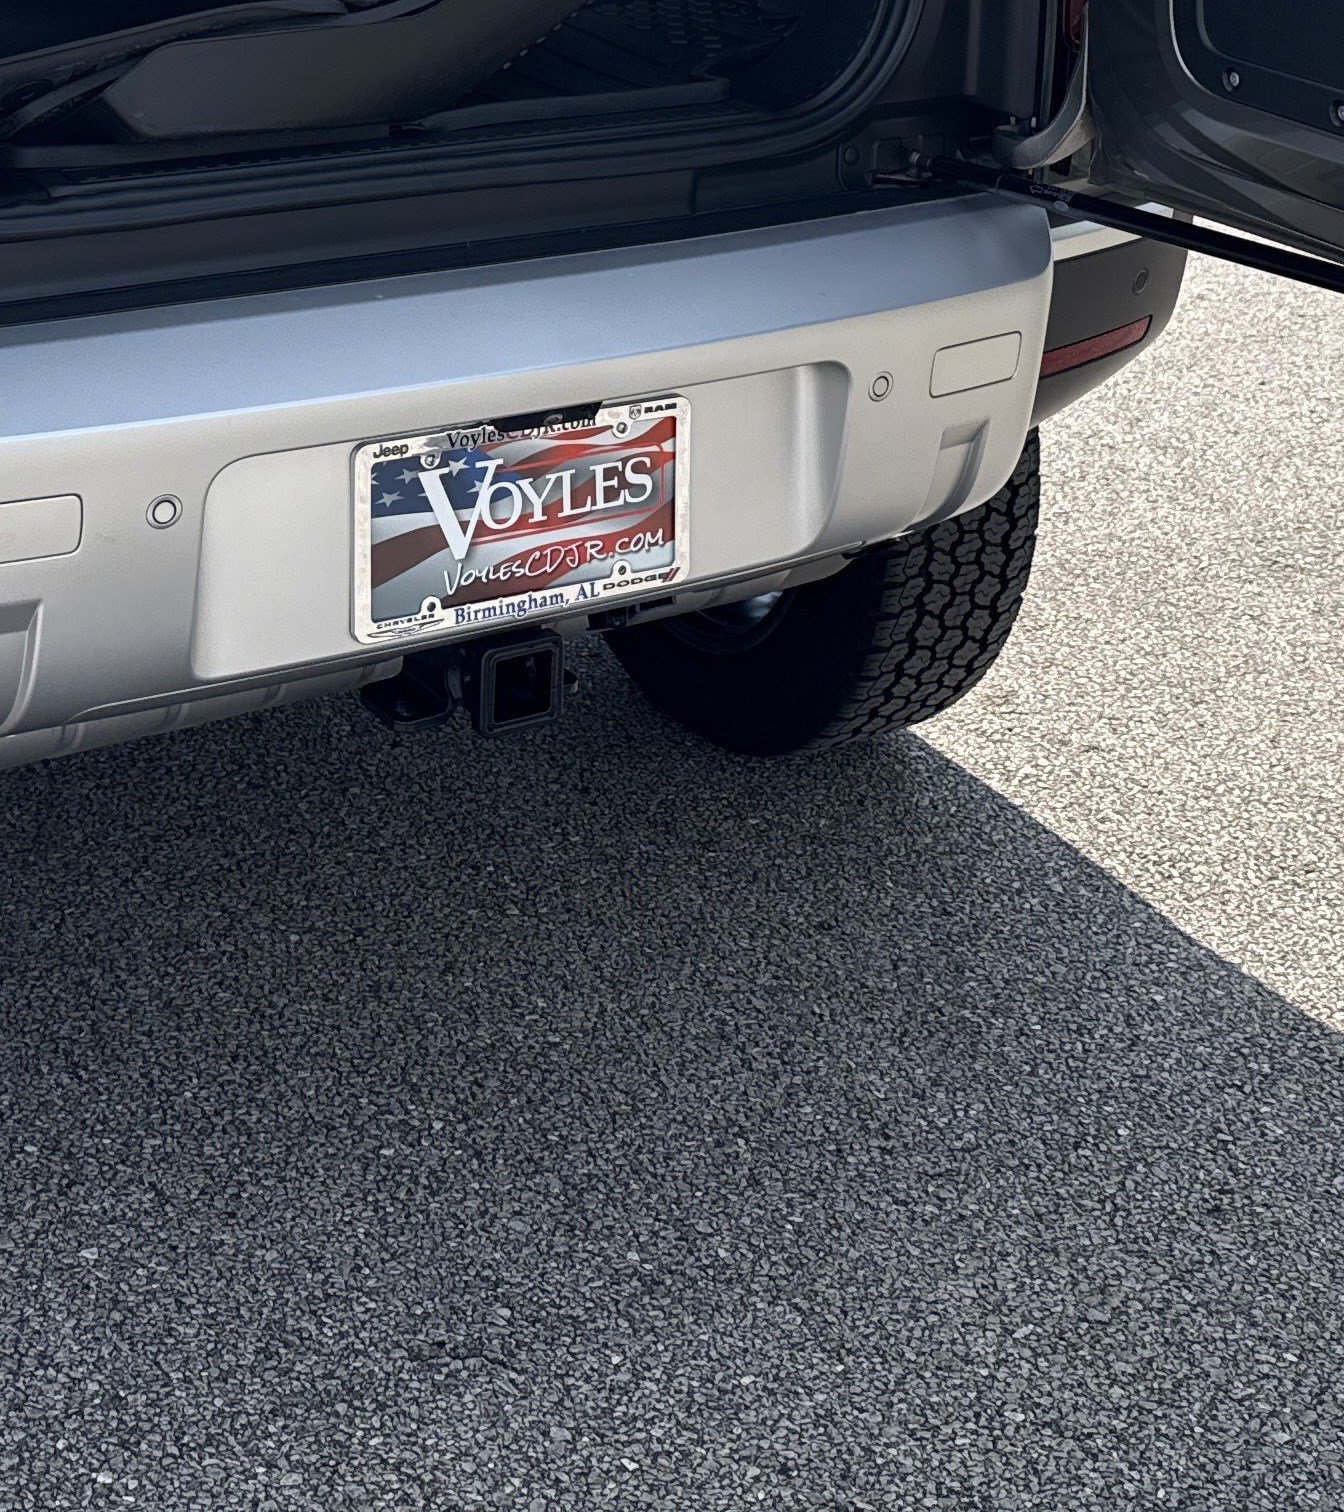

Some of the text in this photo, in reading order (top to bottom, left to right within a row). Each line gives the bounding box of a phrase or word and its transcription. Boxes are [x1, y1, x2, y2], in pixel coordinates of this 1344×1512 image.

[643, 402, 677, 414] RAM
[372, 443, 409, 459] Jeep
[418, 456, 654, 560] VOYLES
[602, 572, 668, 592] DODGE
[453, 579, 600, 626] Birmingham, AL
[375, 613, 435, 630] CHRYSLER
